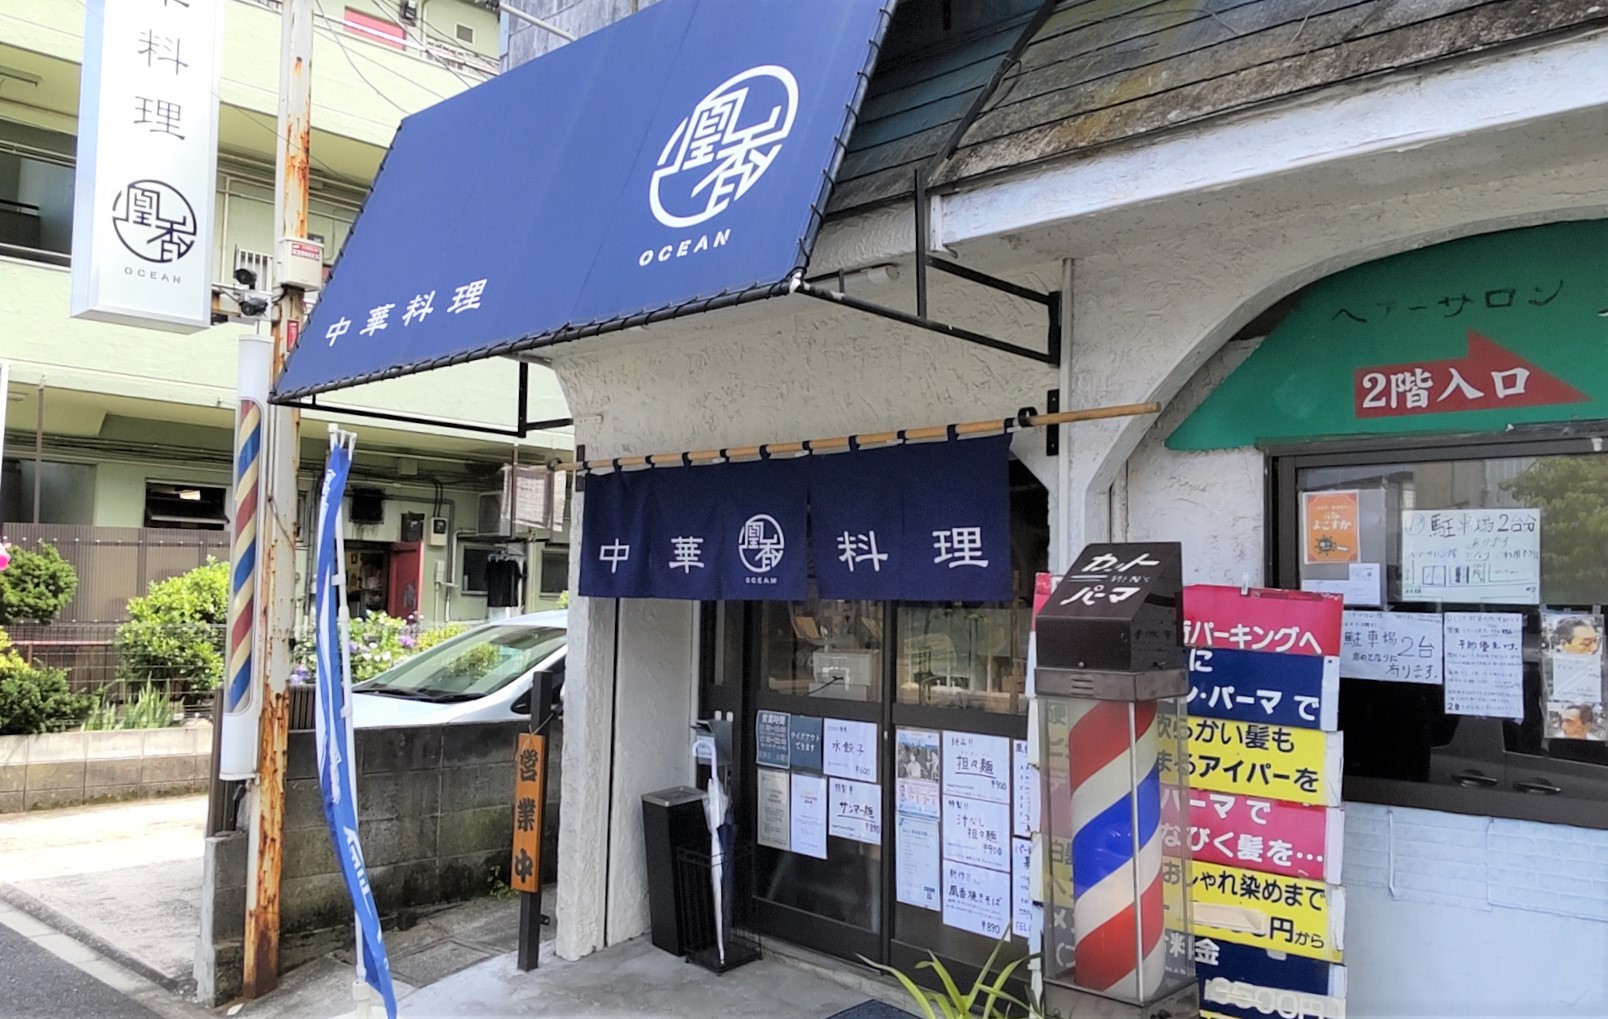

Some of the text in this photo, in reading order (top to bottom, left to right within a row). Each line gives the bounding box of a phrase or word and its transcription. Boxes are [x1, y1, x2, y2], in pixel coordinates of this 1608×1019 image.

[638, 228, 731, 266] OCEAN
[124, 266, 181, 284] OCEAN
[325, 278, 488, 347] 中華料理
[1362, 367, 1530, 409] 2階入口
[1081, 552, 1160, 572] カット
[1060, 584, 1141, 606] パーマ
